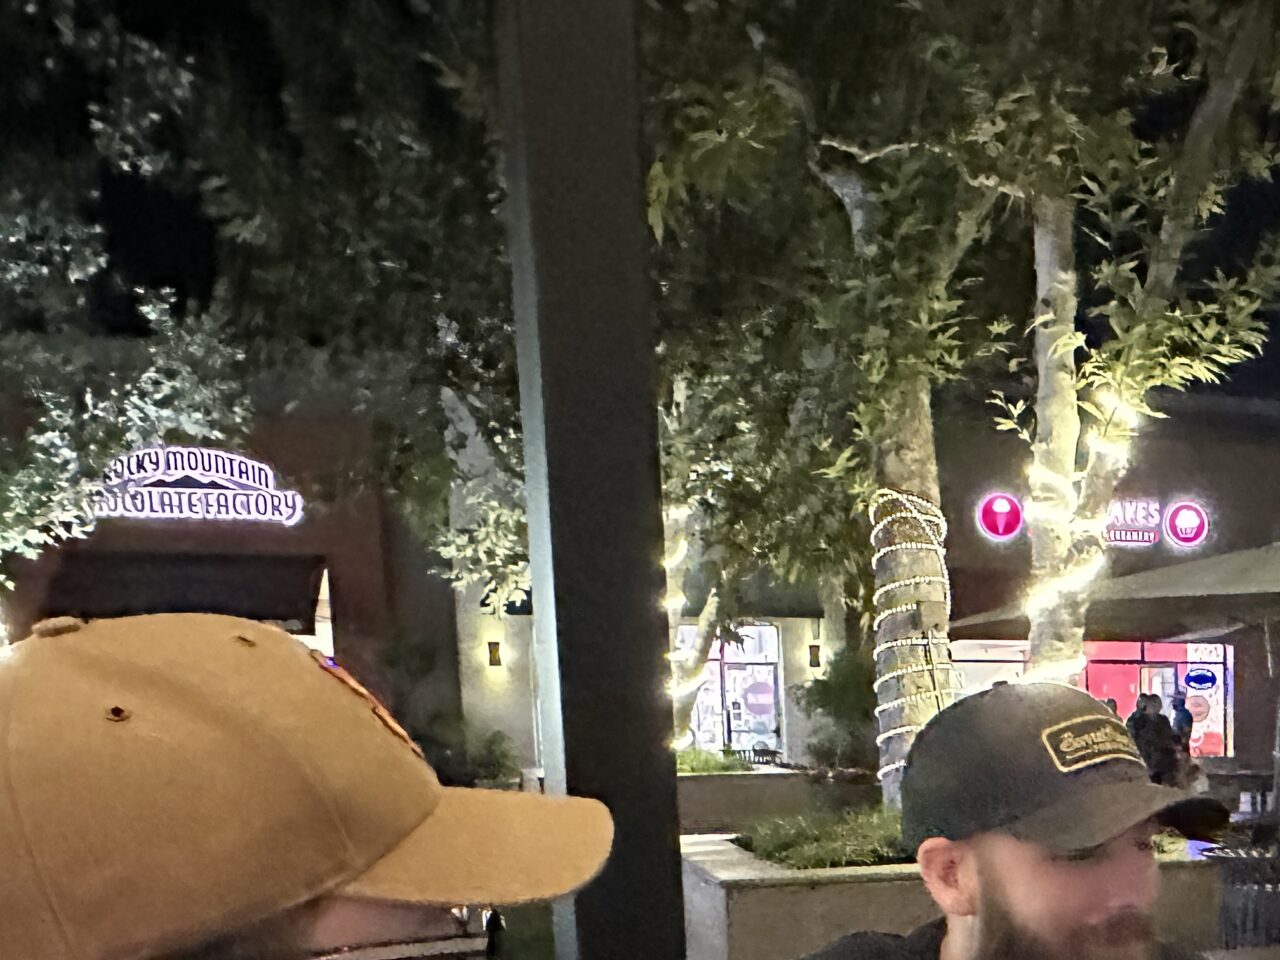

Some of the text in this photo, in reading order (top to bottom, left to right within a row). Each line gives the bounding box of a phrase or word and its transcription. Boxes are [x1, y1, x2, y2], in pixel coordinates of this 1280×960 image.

[104, 450, 270, 489] OCKY MOUNTAIN
[204, 492, 297, 521] FACTORY
